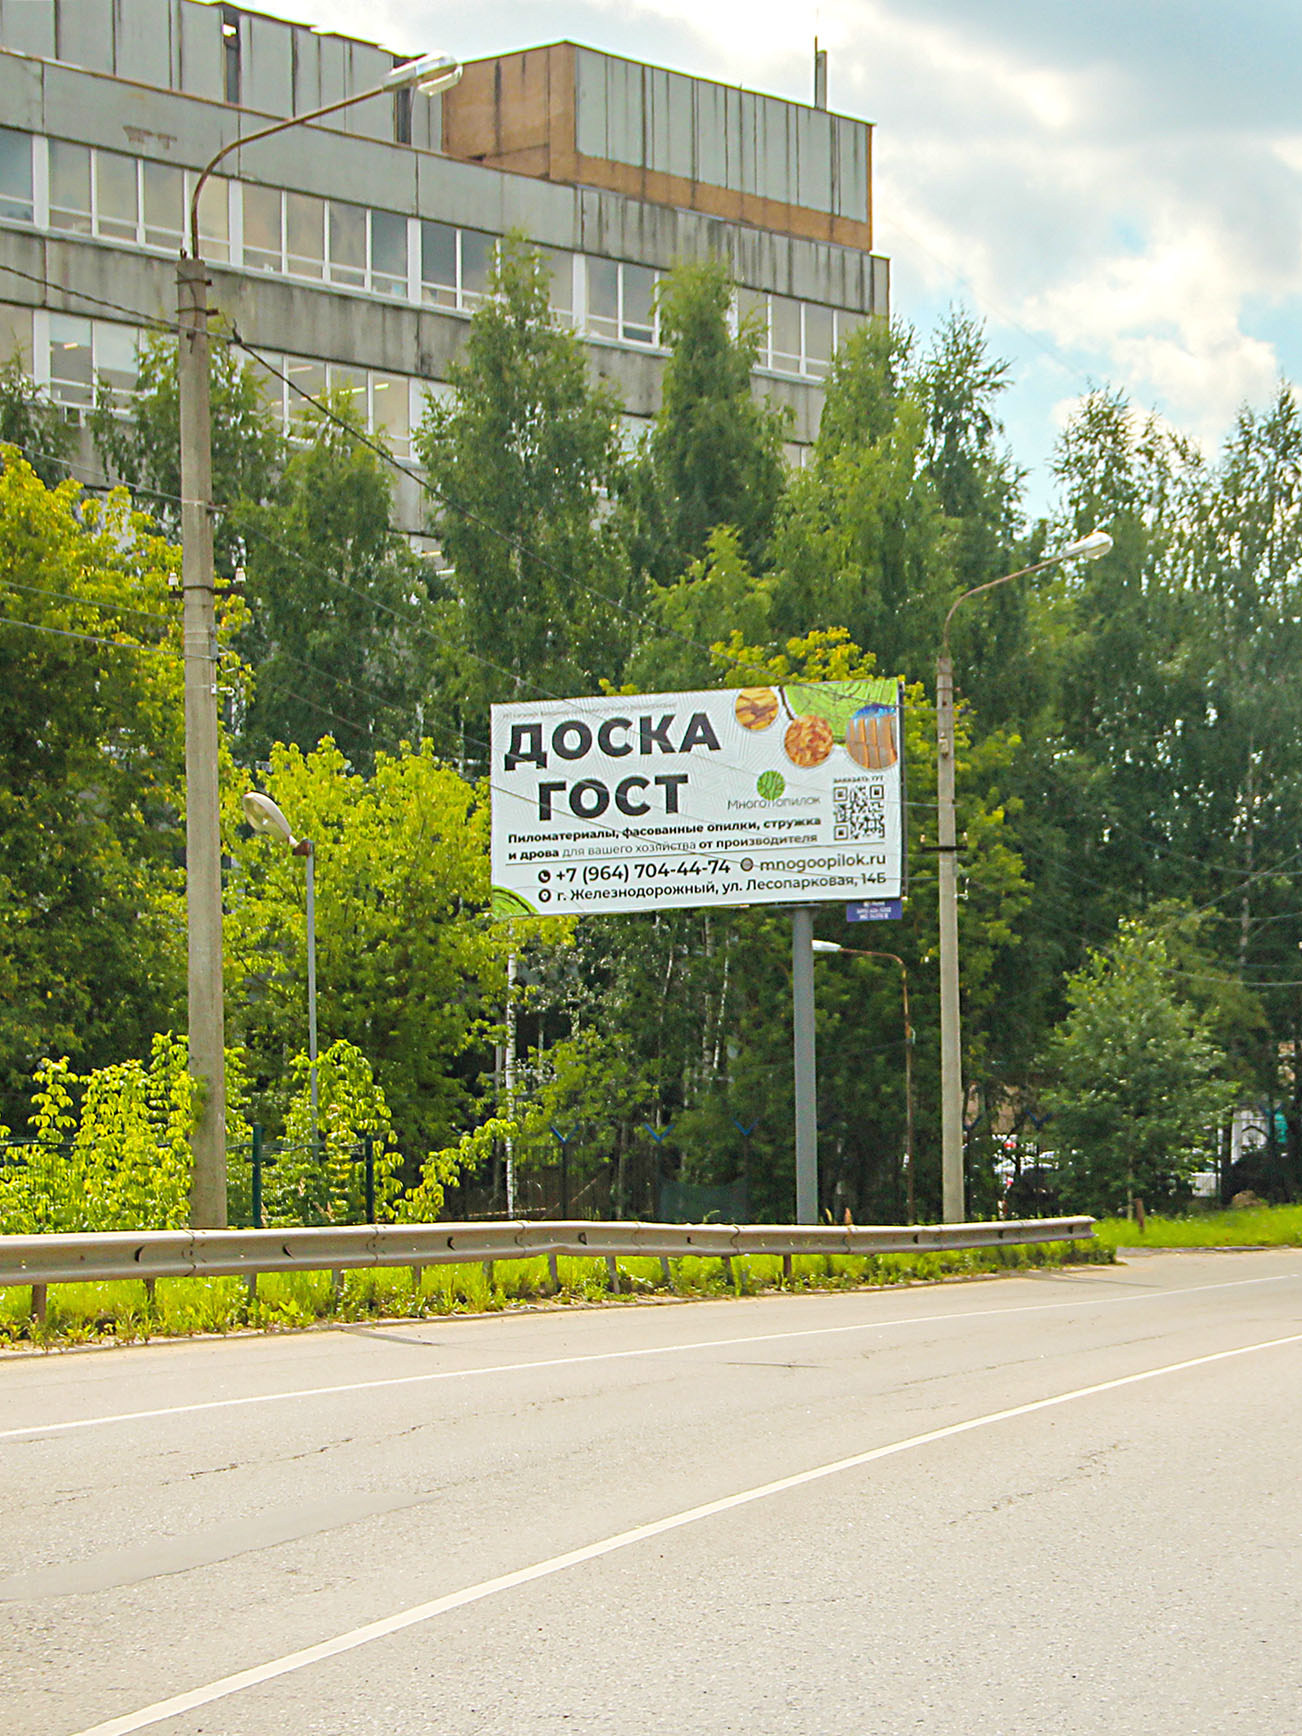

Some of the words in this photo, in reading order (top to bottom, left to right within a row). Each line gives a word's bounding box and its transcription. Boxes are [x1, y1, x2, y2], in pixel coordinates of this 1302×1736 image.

[504, 712, 721, 771] ДОСКА
[538, 774, 689, 821] ГОСТ
[508, 828, 619, 844] Пиломатериалы,
[622, 824, 704, 838] фасованные
[707, 820, 760, 833] опилки,
[763, 817, 822, 830] стружка
[508, 852, 517, 860] и
[520, 850, 559, 862] дрова
[562, 848, 585, 858] для
[588, 844, 632, 857] вашего
[635, 840, 697, 853] хозяйства
[698, 839, 713, 849] от
[716, 833, 818, 849] производителя
[556, 868, 577, 882] +7
[582, 864, 629, 885] (964)
[634, 858, 731, 879] 704-44-74
[760, 853, 886, 873] mnogoopilok.ru
[557, 891, 567, 901] г.
[570, 881, 719, 902] Железнодорожный,
[722, 881, 742, 894] ул.
[746, 876, 858, 891] Лесопарковая,
